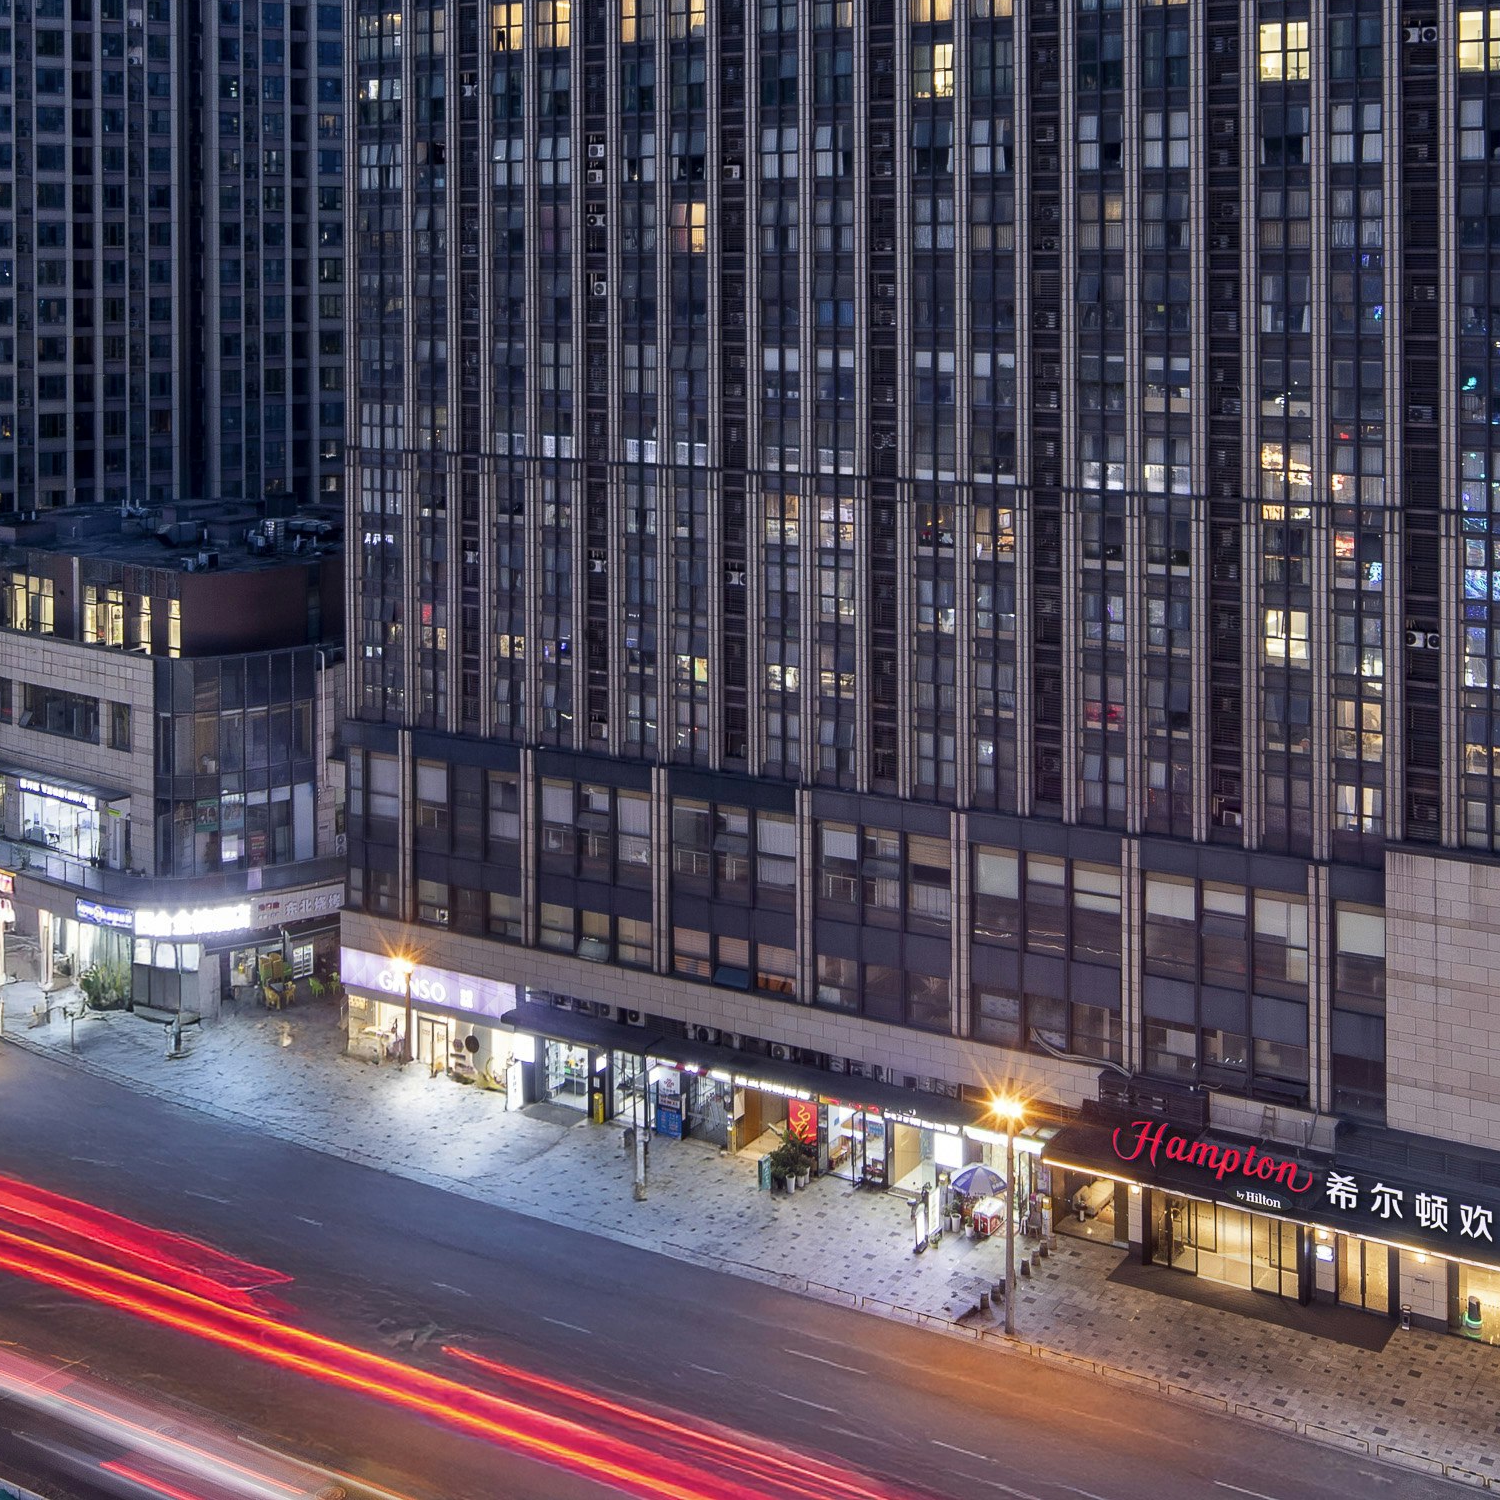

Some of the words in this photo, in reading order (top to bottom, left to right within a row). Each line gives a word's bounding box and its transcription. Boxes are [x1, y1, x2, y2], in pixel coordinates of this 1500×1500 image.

[1112, 1119, 1313, 1194] Hampton
[1236, 1189, 1246, 1203] by
[1246, 1191, 1282, 1209] Hilton
